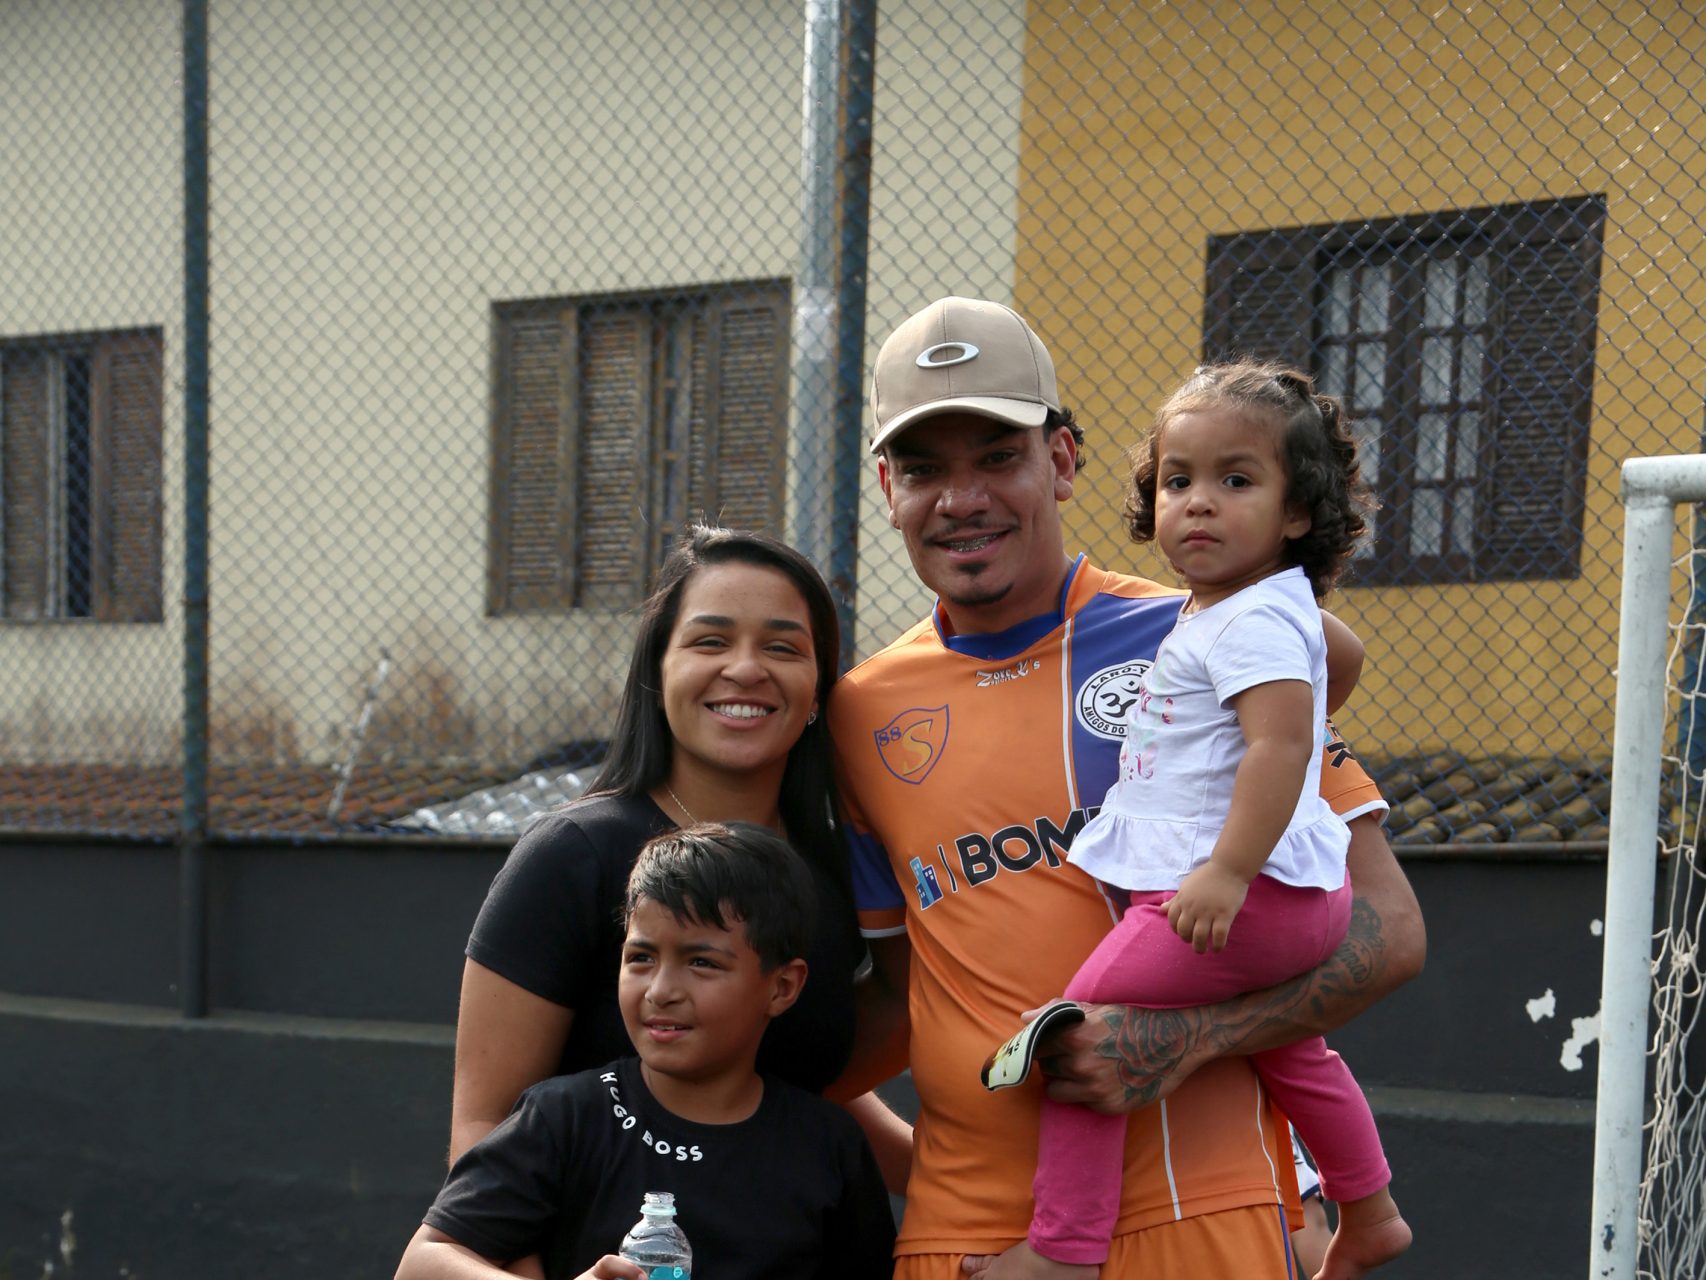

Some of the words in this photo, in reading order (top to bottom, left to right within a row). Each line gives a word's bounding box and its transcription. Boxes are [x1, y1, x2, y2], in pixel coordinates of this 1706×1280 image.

[1091, 667, 1147, 690] LARO-Y
[1083, 706, 1110, 732] AMIGOS
[1111, 726, 1125, 735] DO
[878, 726, 902, 747] 88
[599, 1071, 637, 1130] HUGO
[642, 1130, 704, 1162] BOSS
